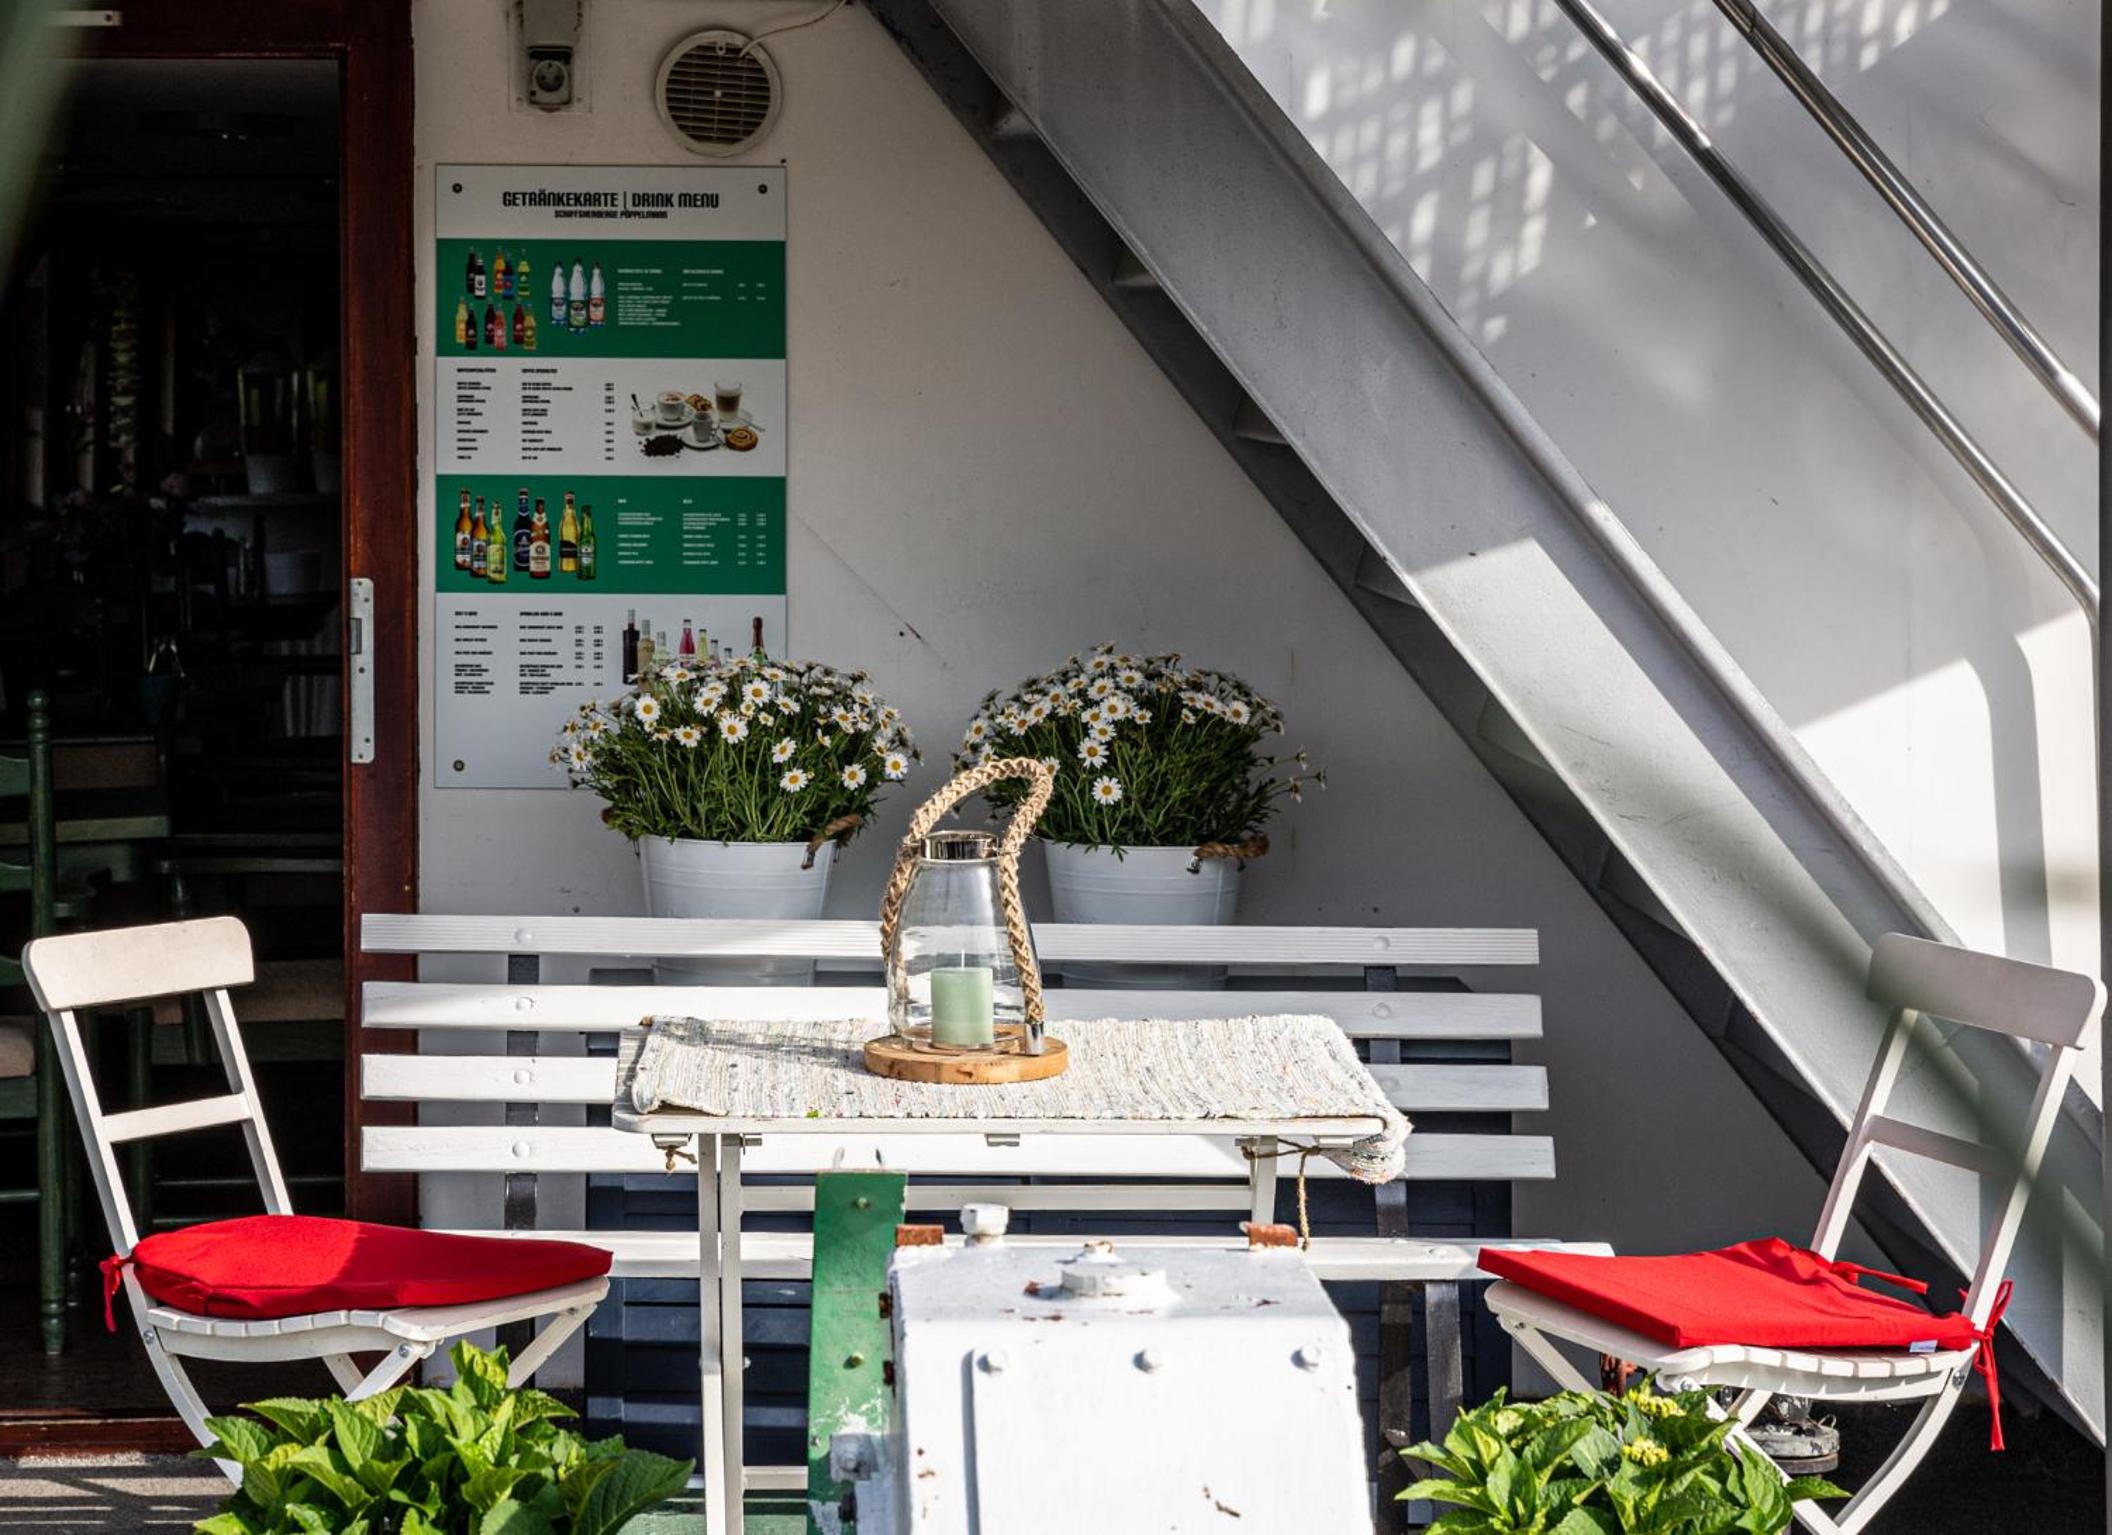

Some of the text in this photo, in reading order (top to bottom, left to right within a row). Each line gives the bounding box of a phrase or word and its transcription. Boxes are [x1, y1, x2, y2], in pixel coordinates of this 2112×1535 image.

[503, 189, 619, 207] GETRÄNKEKARTE
[632, 192, 675, 208] DRINK
[678, 193, 720, 208] MENU
